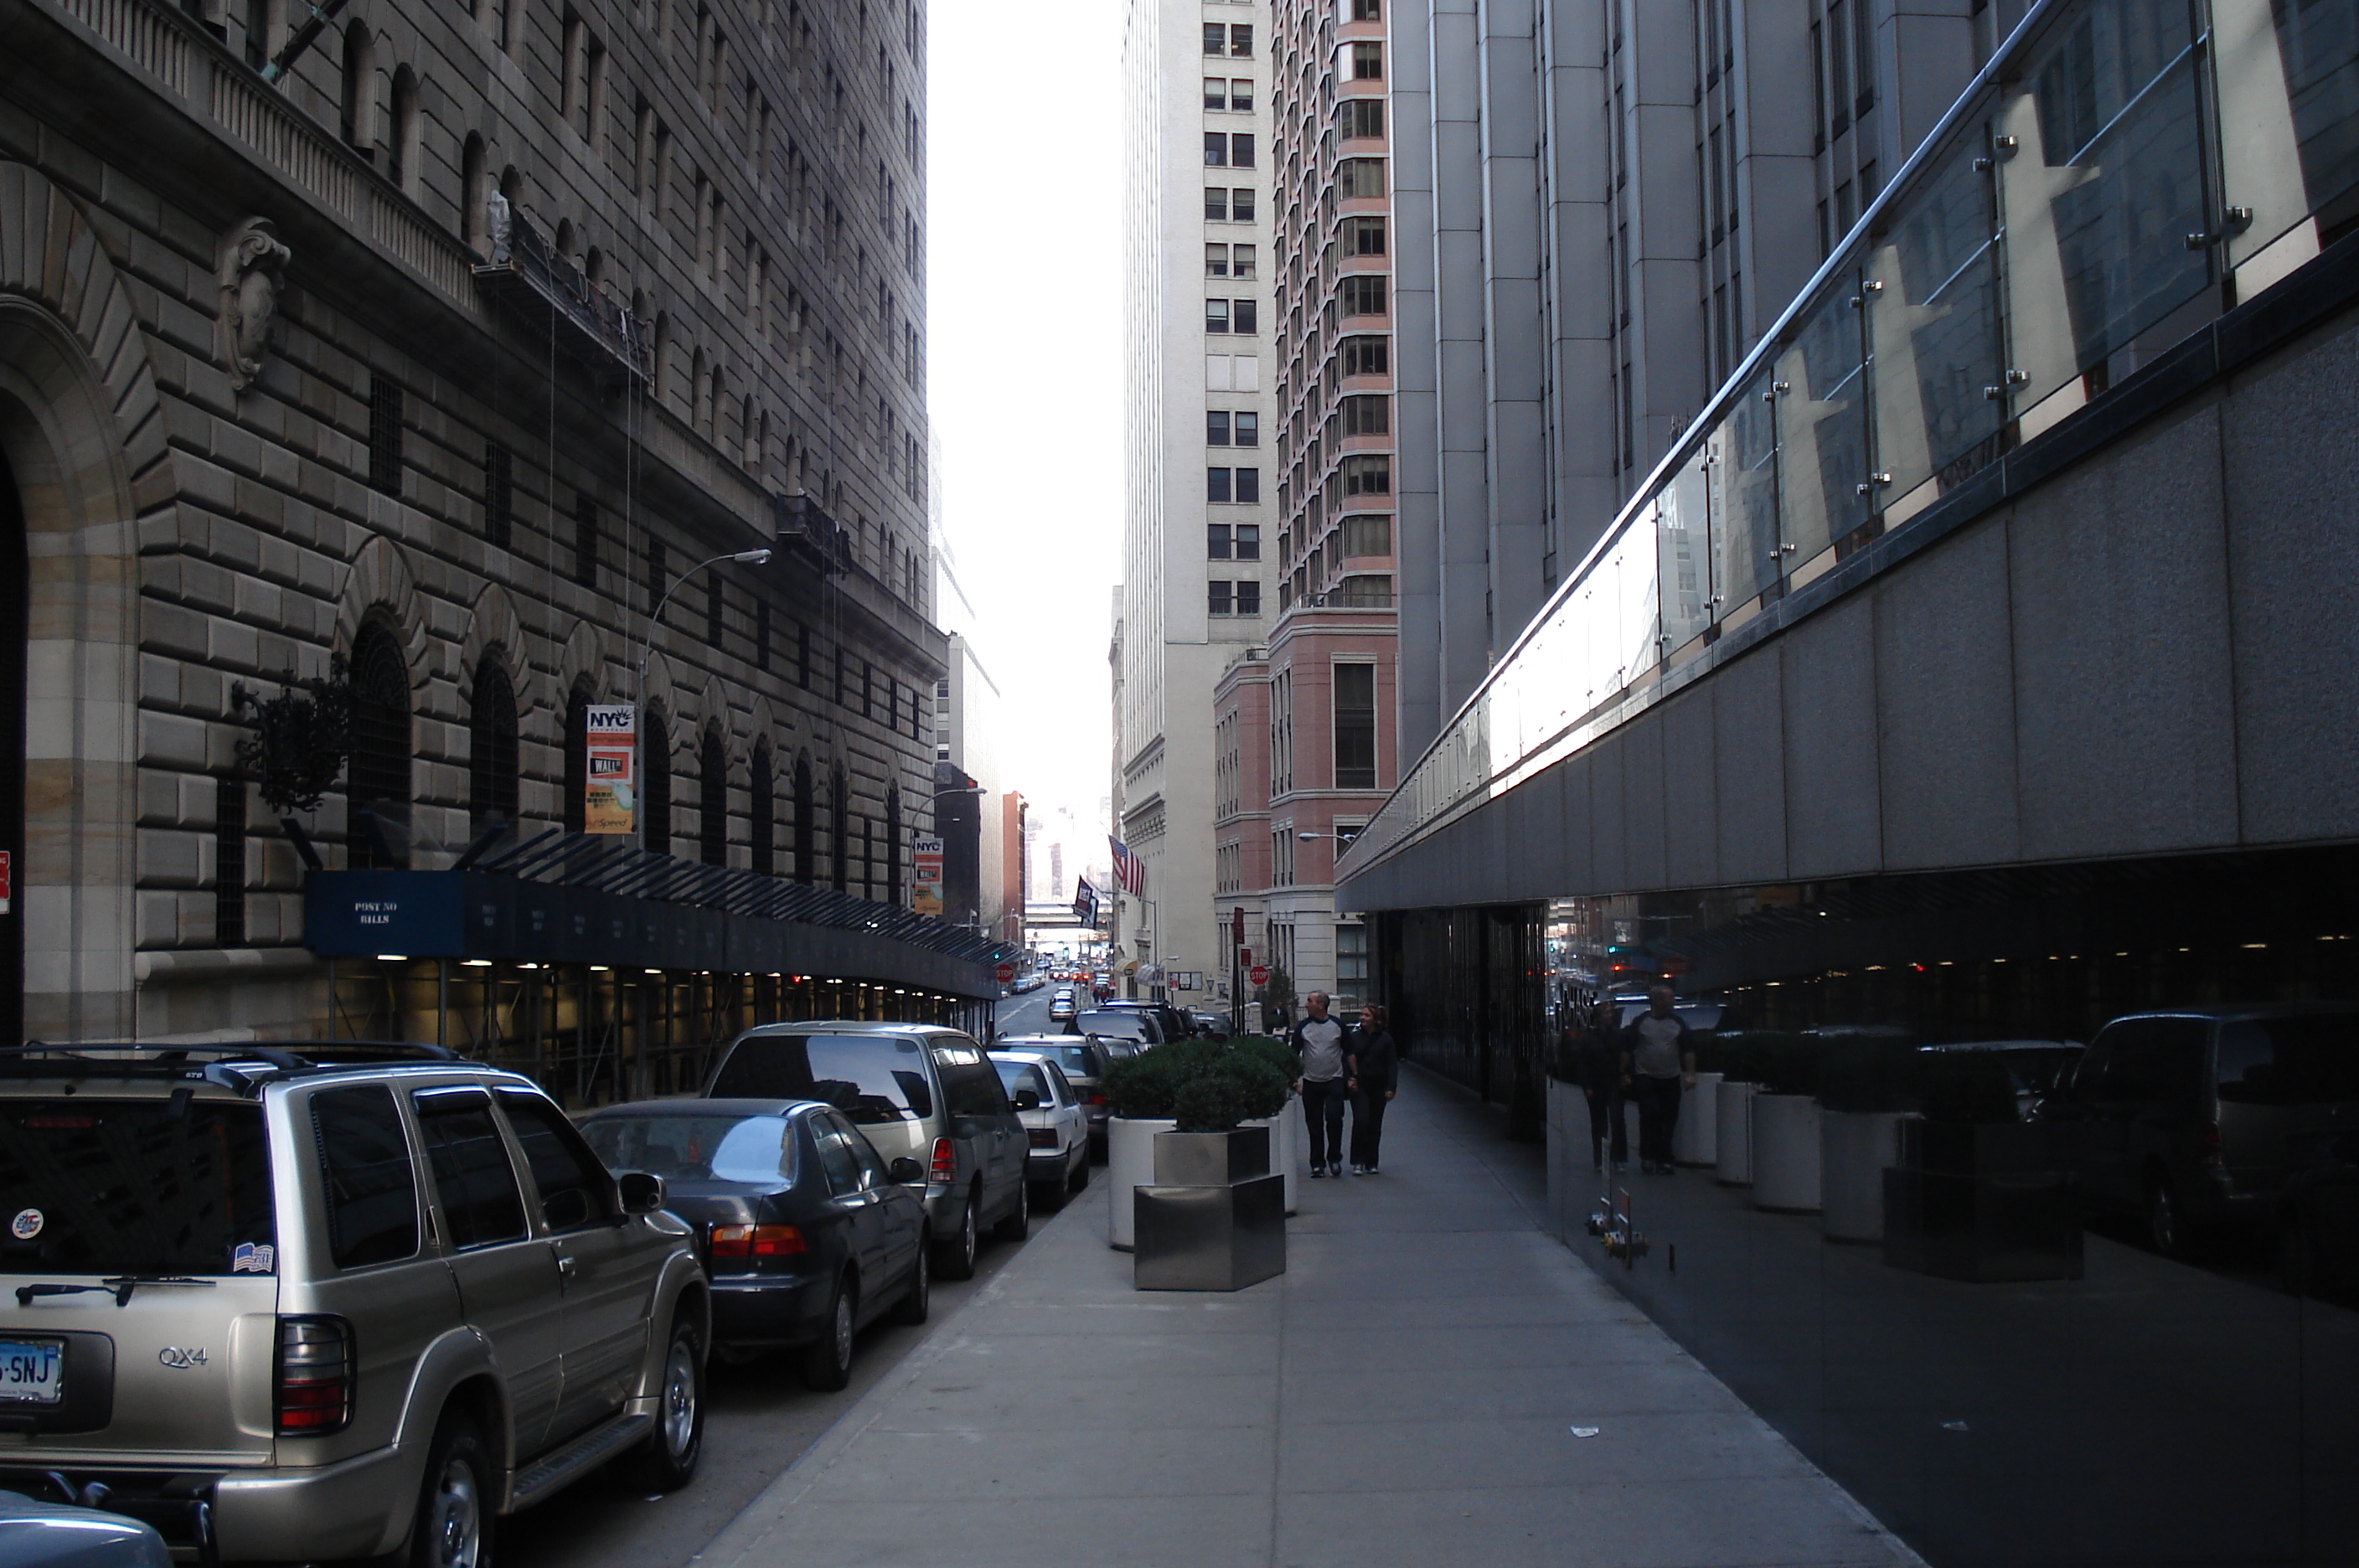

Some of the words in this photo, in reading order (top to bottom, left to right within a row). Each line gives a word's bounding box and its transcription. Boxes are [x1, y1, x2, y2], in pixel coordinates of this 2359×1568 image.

[591, 711, 630, 727] NYC
[595, 759, 616, 773] WALL
[598, 818, 627, 828] Speed
[916, 841, 940, 851] NYC
[354, 902, 380, 912] POST
[383, 902, 397, 912] NO
[360, 915, 390, 924] BILLS
[996, 969, 1013, 977] STOP
[1251, 971, 1268, 980] STOP
[158, 1346, 209, 1369] QX4
